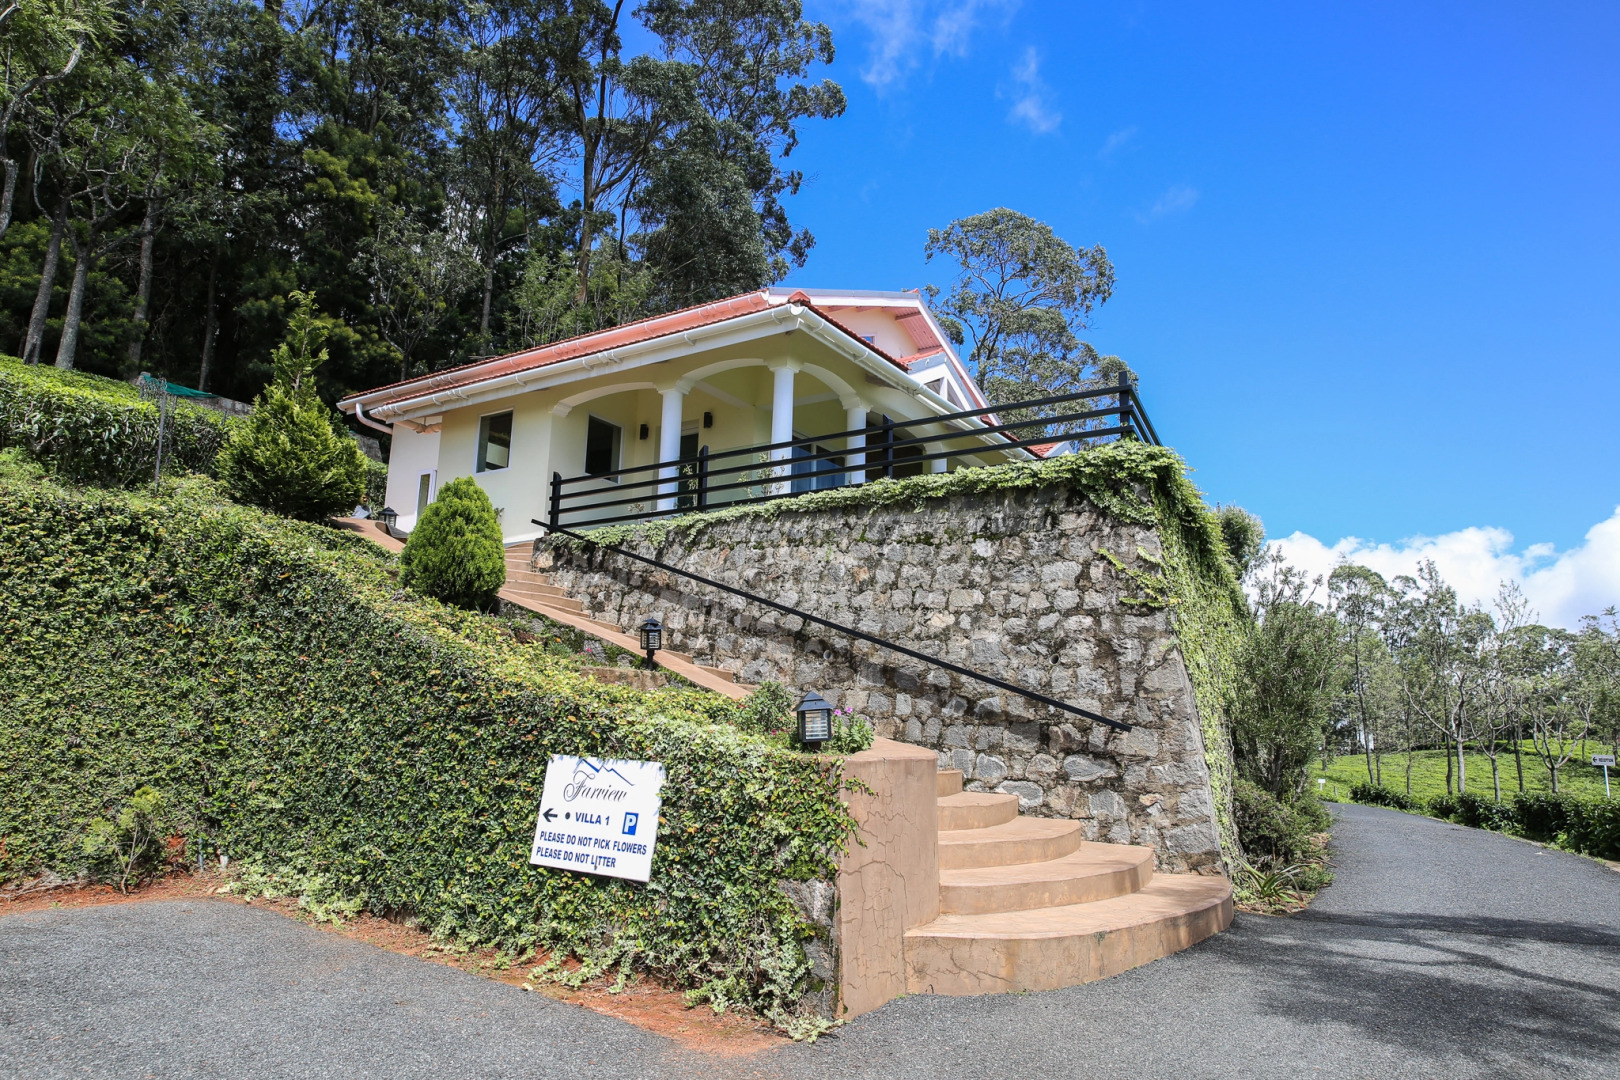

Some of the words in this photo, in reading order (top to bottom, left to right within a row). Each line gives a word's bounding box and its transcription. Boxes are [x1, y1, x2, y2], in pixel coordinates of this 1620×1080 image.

[563, 770, 627, 802] Farview
[575, 812, 602, 825] VILLA
[605, 815, 610, 826] 1
[623, 814, 637, 833] P
[540, 830, 565, 843] PLEASE
[566, 834, 576, 845] DO
[577, 836, 593, 847] NOT
[593, 838, 611, 850] PICK
[613, 841, 647, 855] FLOWERS
[536, 846, 562, 860] PLEASE
[563, 850, 574, 862] DO
[574, 852, 590, 864] NOT
[591, 855, 616, 868] LITTER
